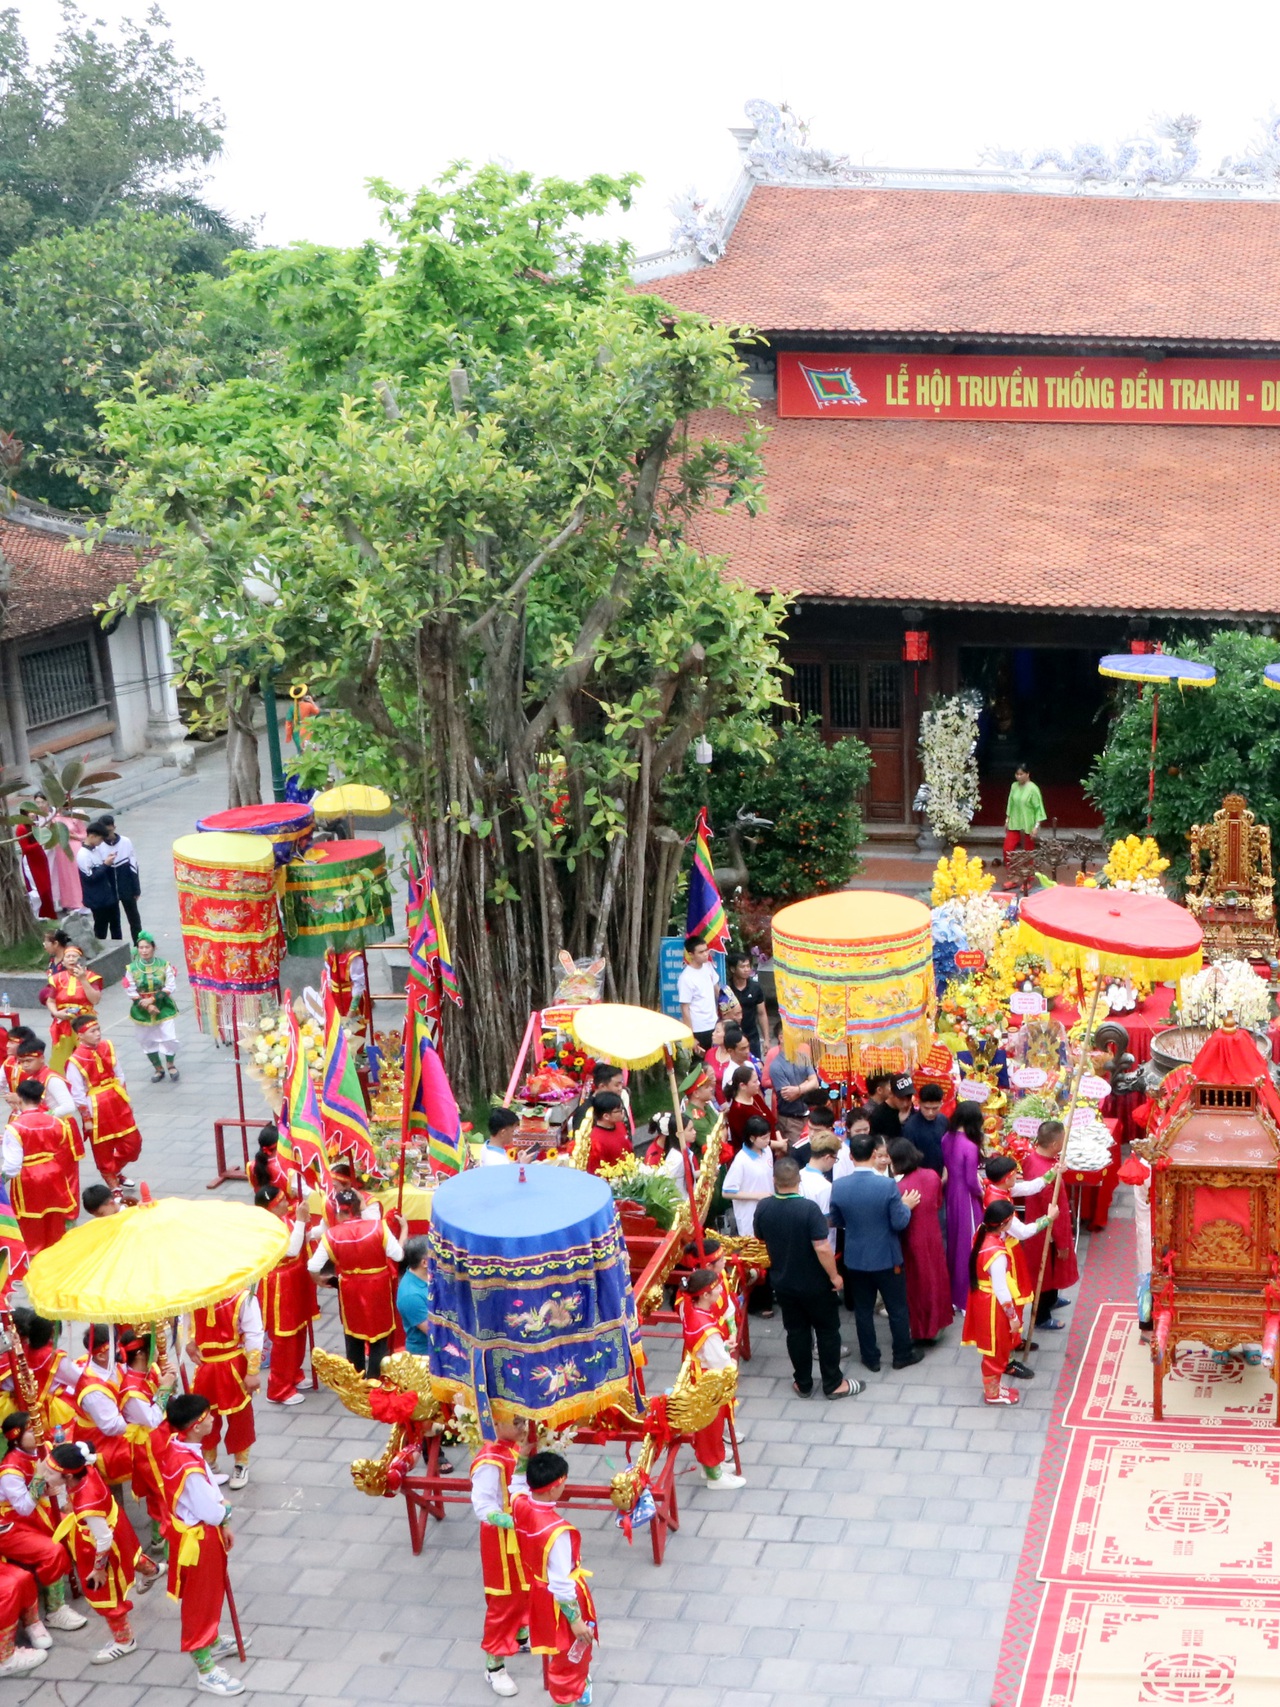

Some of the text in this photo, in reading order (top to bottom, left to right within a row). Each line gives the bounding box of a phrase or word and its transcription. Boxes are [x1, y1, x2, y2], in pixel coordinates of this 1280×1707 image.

[885, 362, 909, 406] LỄ
[916, 368, 951, 413] HỘI
[957, 366, 1038, 408] TRUYỀN
[1044, 366, 1114, 409] THỐNG
[1120, 368, 1163, 409] ĐỀN
[1169, 378, 1239, 410] TRANH
